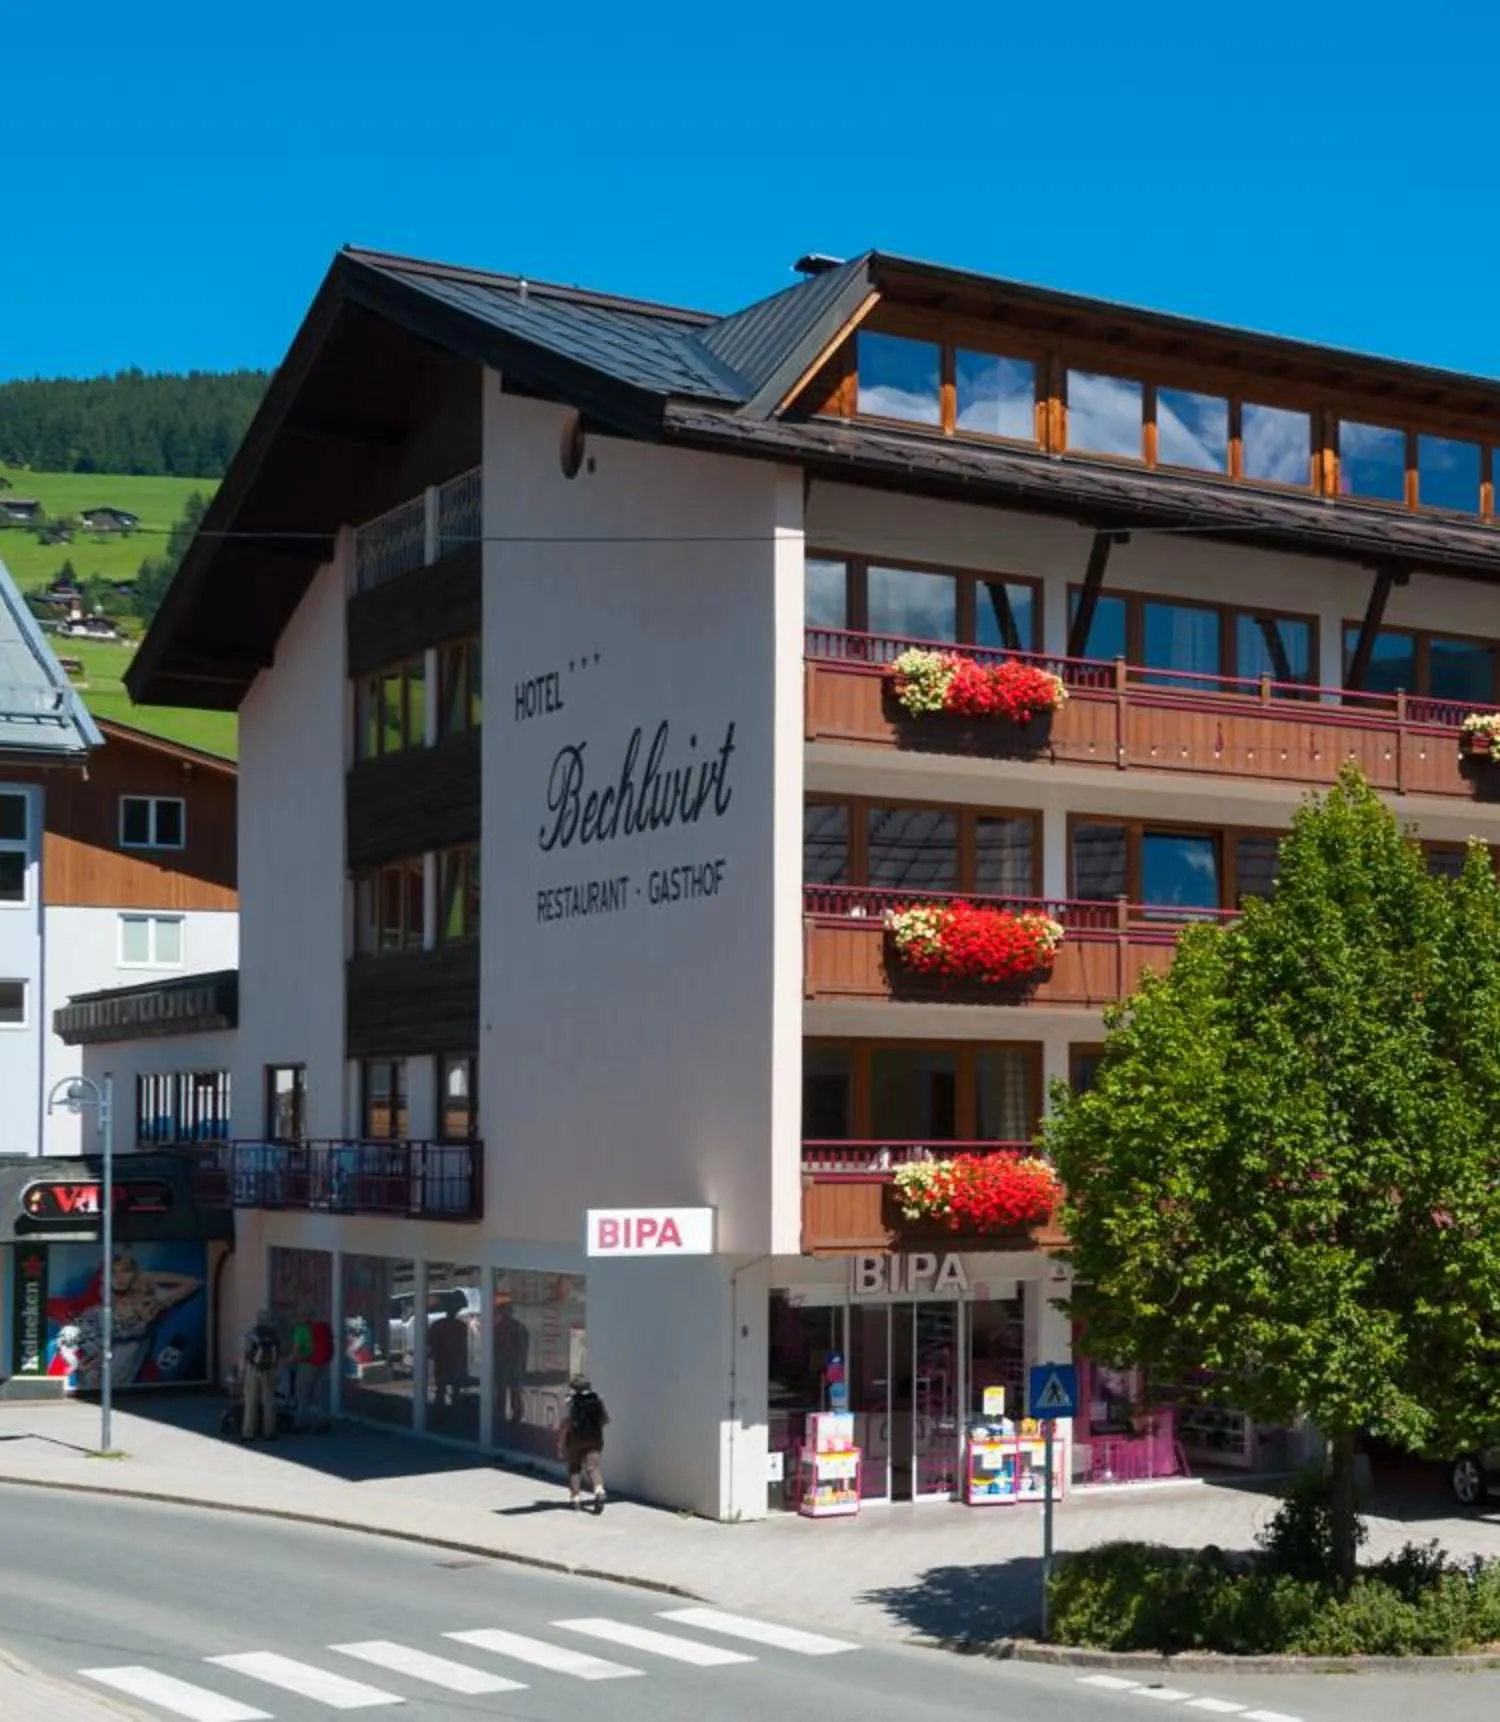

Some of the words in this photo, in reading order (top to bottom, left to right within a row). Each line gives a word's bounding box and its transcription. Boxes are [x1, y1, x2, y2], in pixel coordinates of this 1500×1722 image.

[514, 671, 565, 721] HOTEL
[539, 719, 736, 851] Bechlwirt
[536, 875, 630, 923] RESTAURANT
[649, 858, 727, 904] GASTHOF
[597, 1217, 683, 1249] BIPA
[853, 1252, 969, 1295] BIPA
[20, 1281, 40, 1372] Heineken
